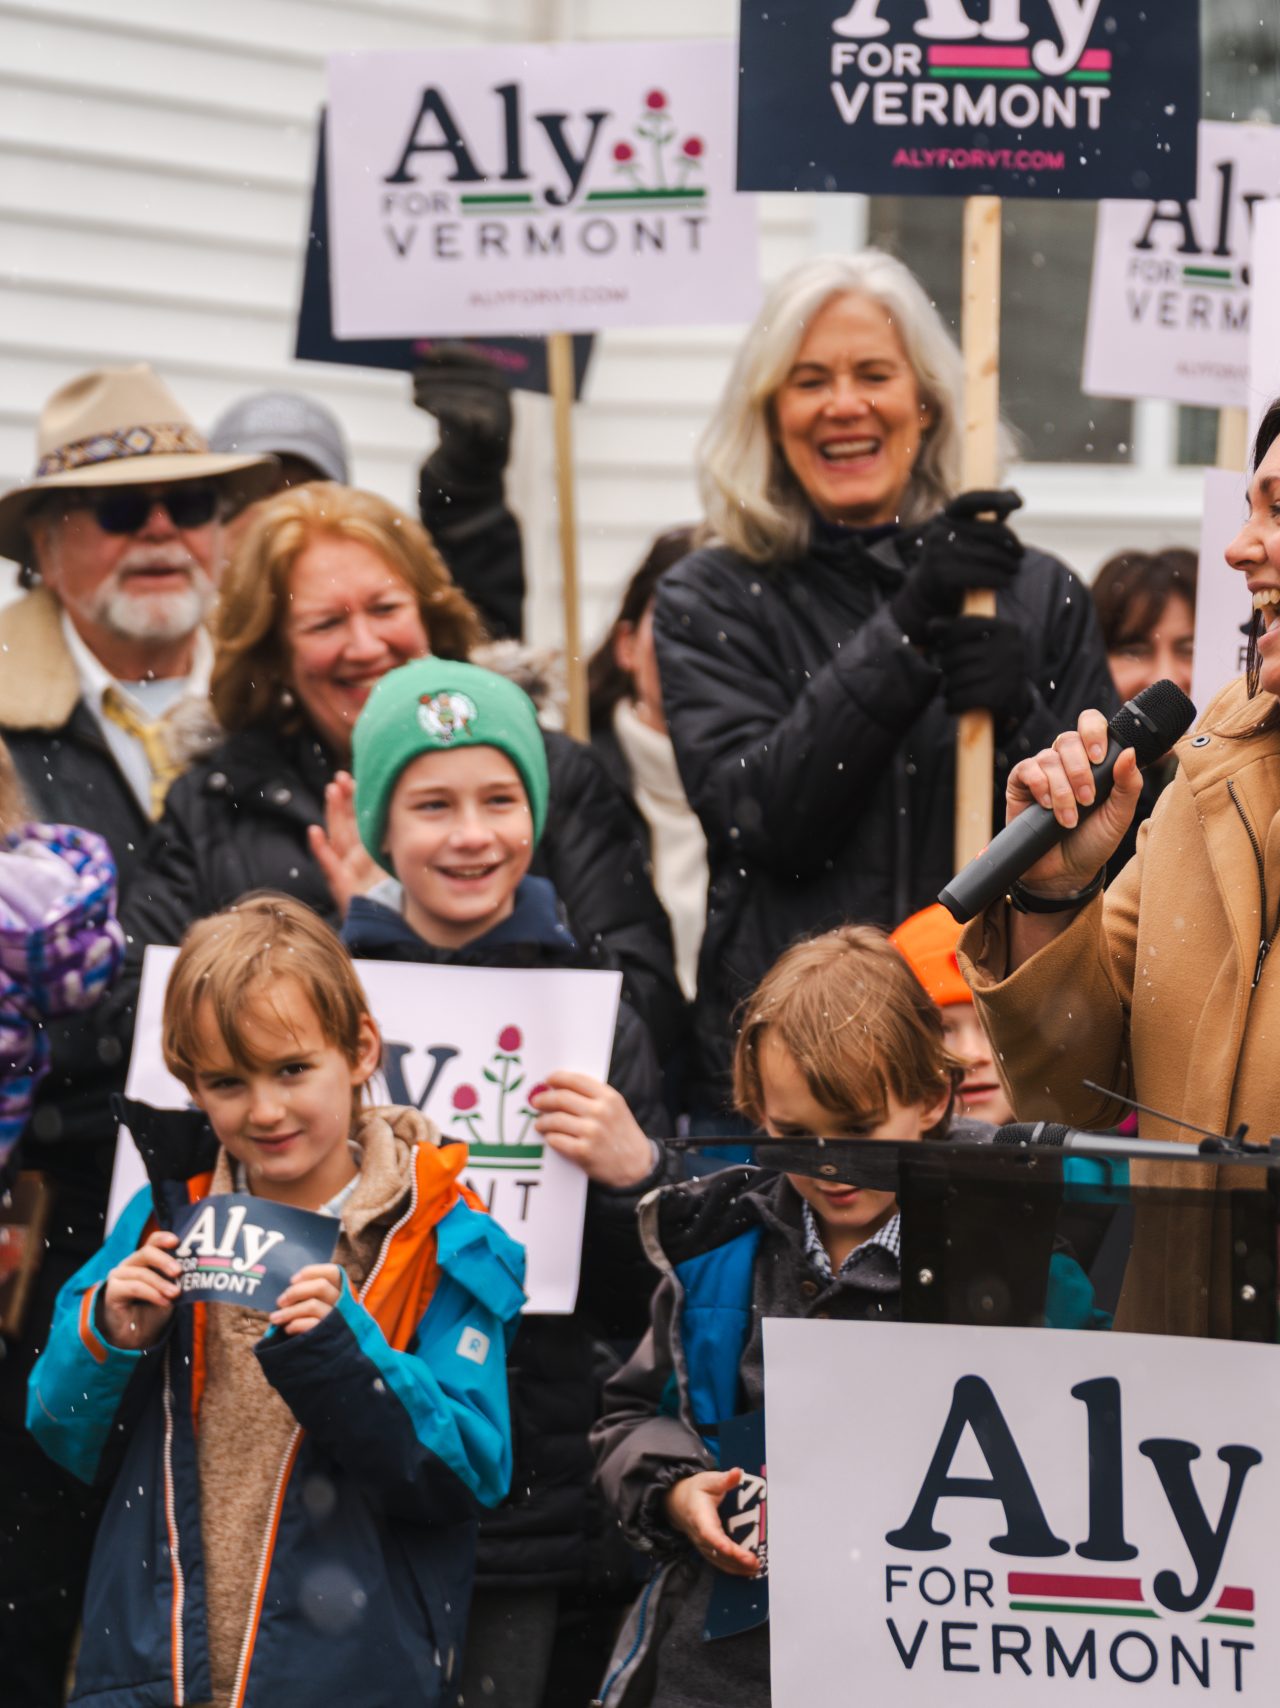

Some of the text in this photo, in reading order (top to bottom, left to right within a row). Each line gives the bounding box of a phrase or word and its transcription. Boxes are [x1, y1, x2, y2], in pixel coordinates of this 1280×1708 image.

[831, 42, 921, 77] FOR
[831, 81, 1111, 129] VERMONT
[383, 82, 610, 206] Aly
[892, 147, 1065, 170] ALYFORVT.COM
[382, 193, 453, 217] FOR
[1134, 163, 1272, 284] Al
[385, 217, 709, 260] VERMONT
[1128, 290, 1250, 331] VERM
[176, 1206, 285, 1272] Aly
[885, 1373, 1263, 1612] Aly
[885, 1564, 995, 1608] FOR
[885, 1617, 1256, 1693] VERMONT
